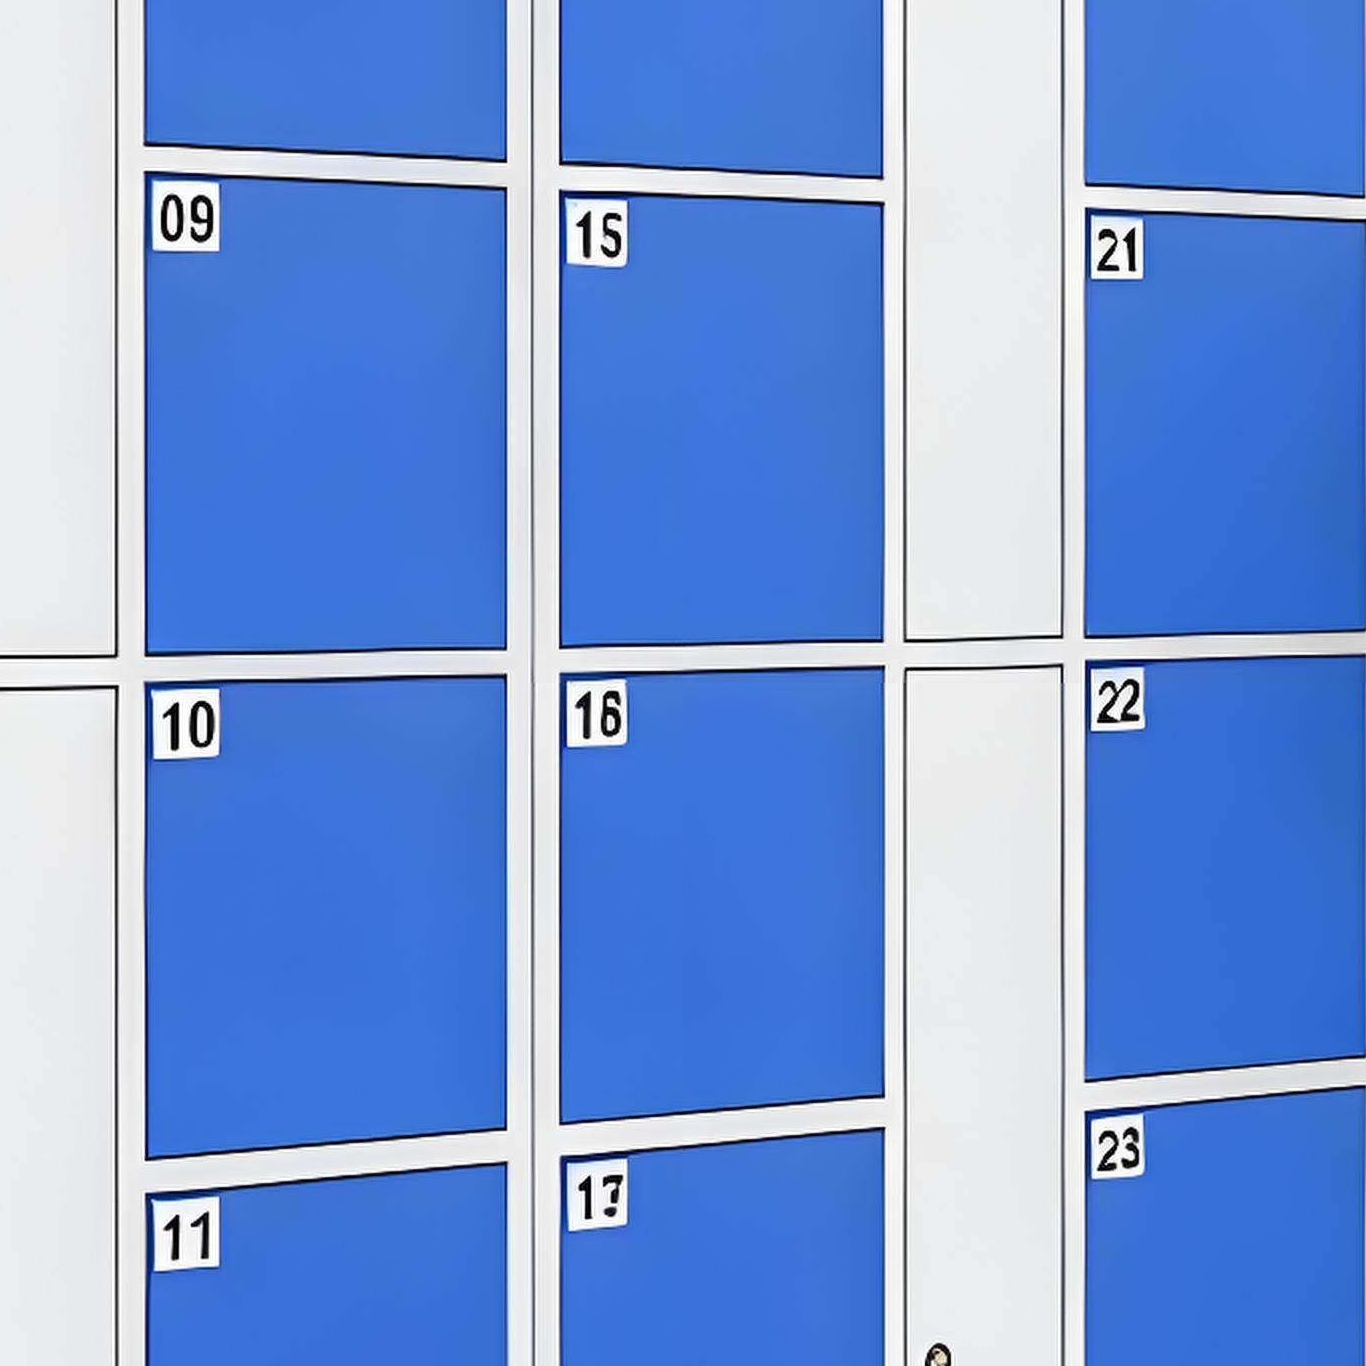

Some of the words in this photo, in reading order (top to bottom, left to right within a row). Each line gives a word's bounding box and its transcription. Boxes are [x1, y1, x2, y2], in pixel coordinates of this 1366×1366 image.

[160, 194, 214, 244] 09
[576, 210, 622, 259] 15
[1096, 227, 1137, 272] 21
[162, 700, 215, 751] 10
[1096, 678, 1140, 724] 22
[1096, 1126, 1140, 1172] 23
[163, 1211, 210, 1261] 11
